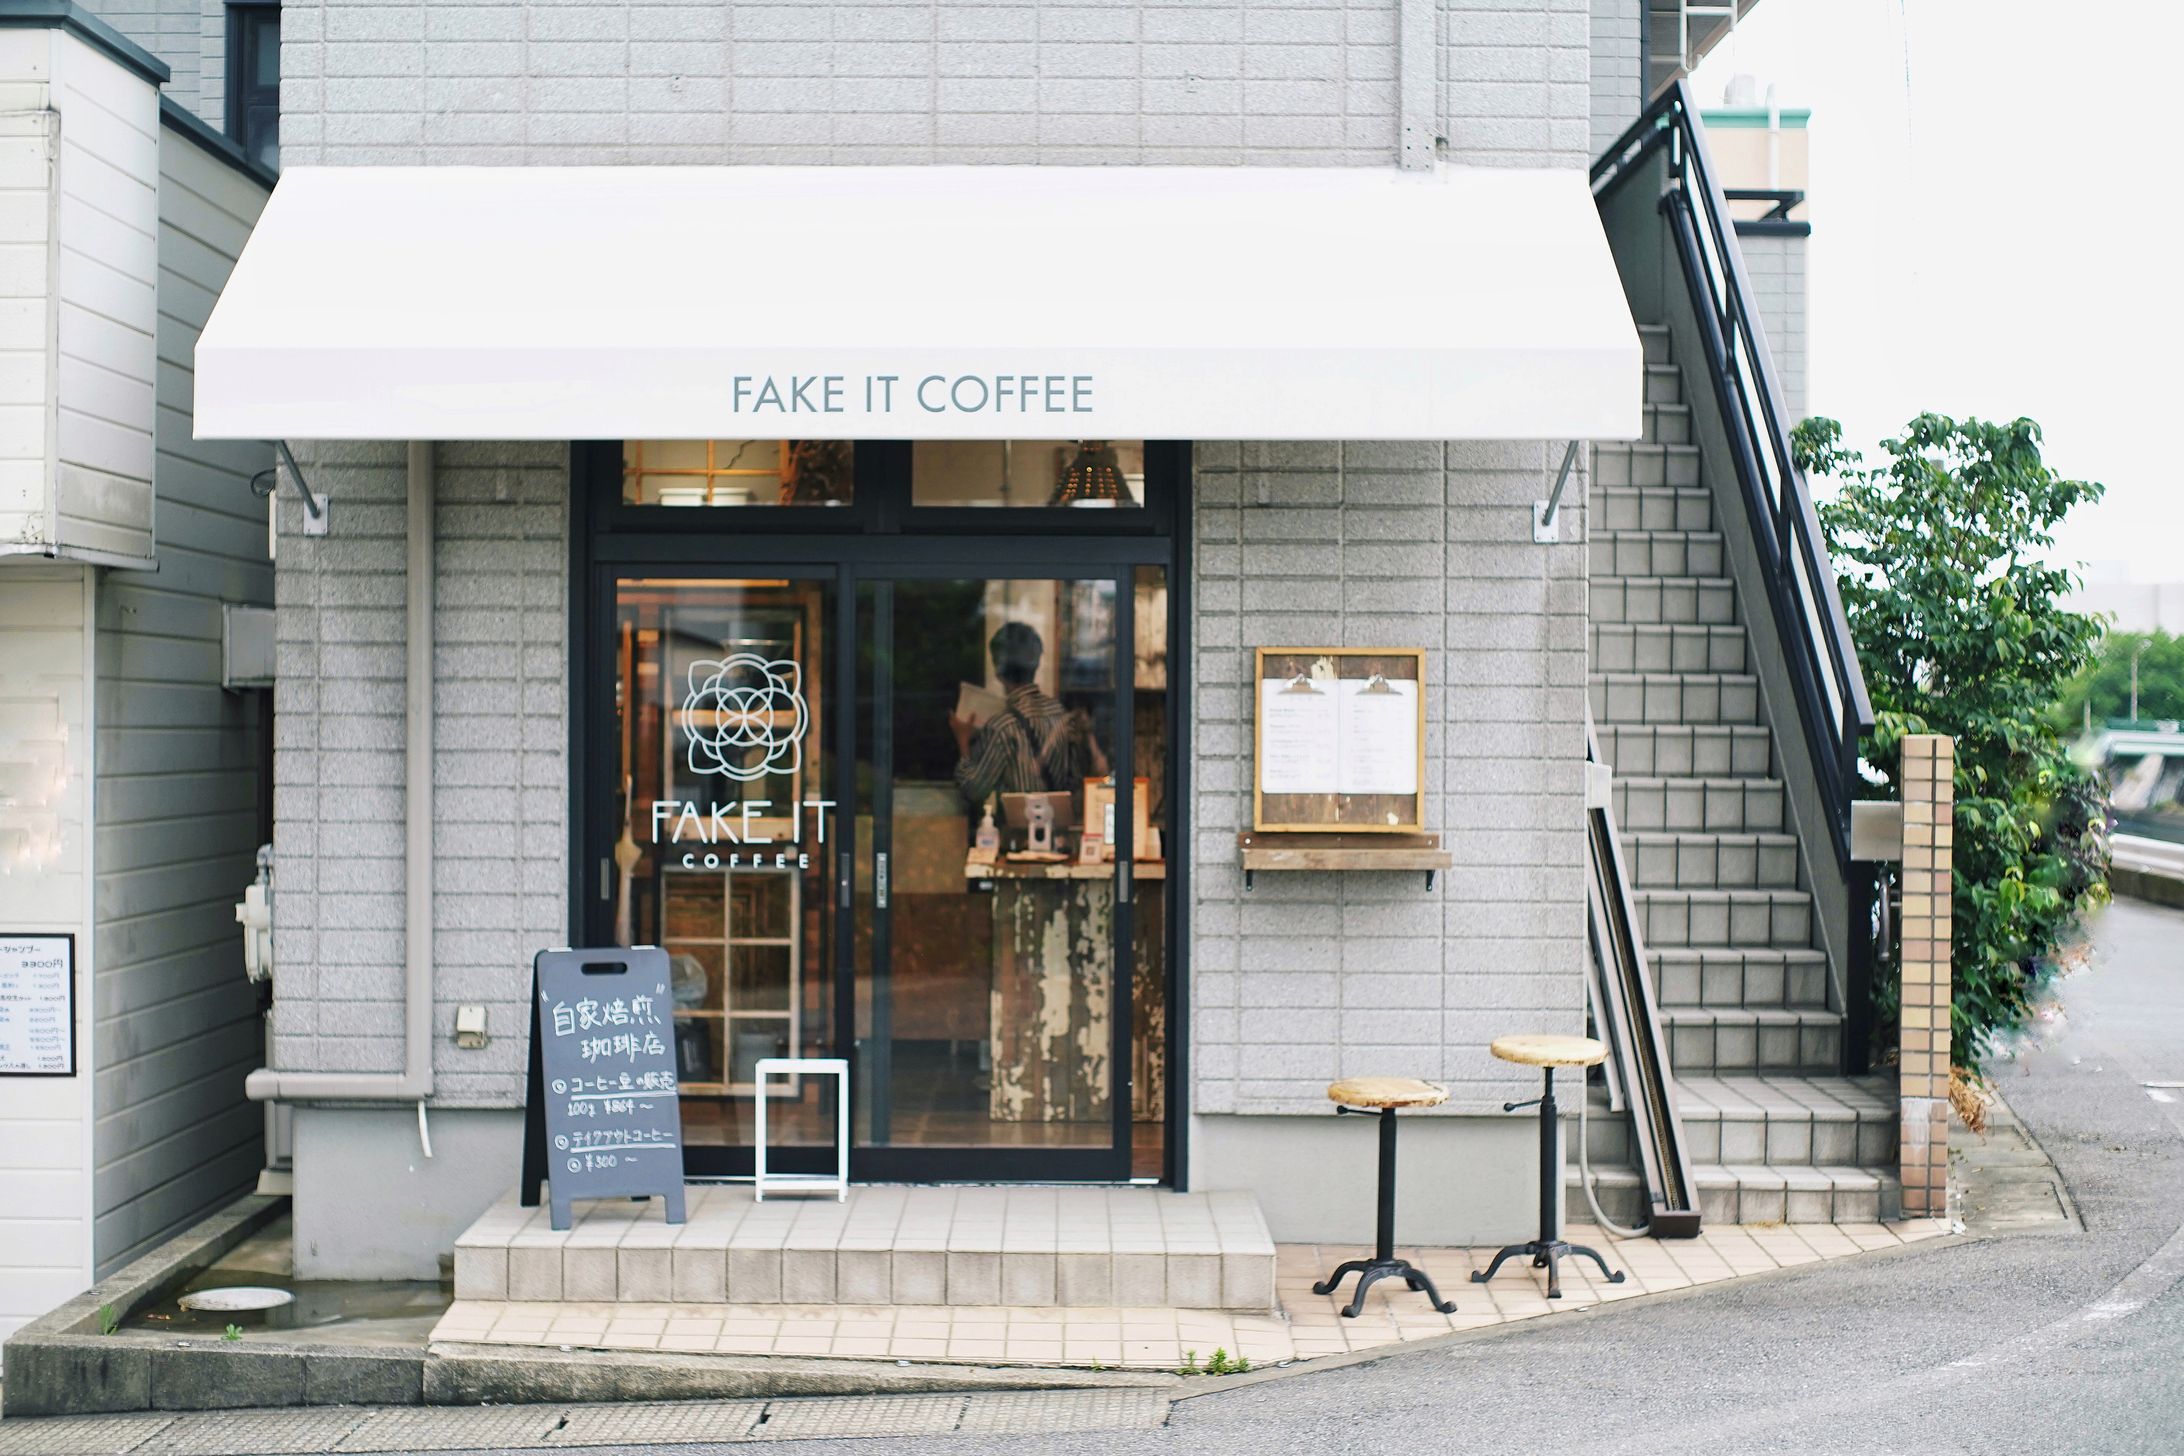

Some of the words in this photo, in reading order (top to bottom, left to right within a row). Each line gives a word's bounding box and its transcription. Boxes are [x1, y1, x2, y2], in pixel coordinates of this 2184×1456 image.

[733, 375, 845, 413] FAKE
[866, 375, 899, 413] IT
[916, 375, 1094, 413] COFFEE
[652, 800, 773, 844] FAKE
[793, 800, 837, 844] IT
[682, 852, 810, 869] COFFEE
[580, 1030, 667, 1064] 珈琲店
[567, 1101, 597, 1118] 100g
